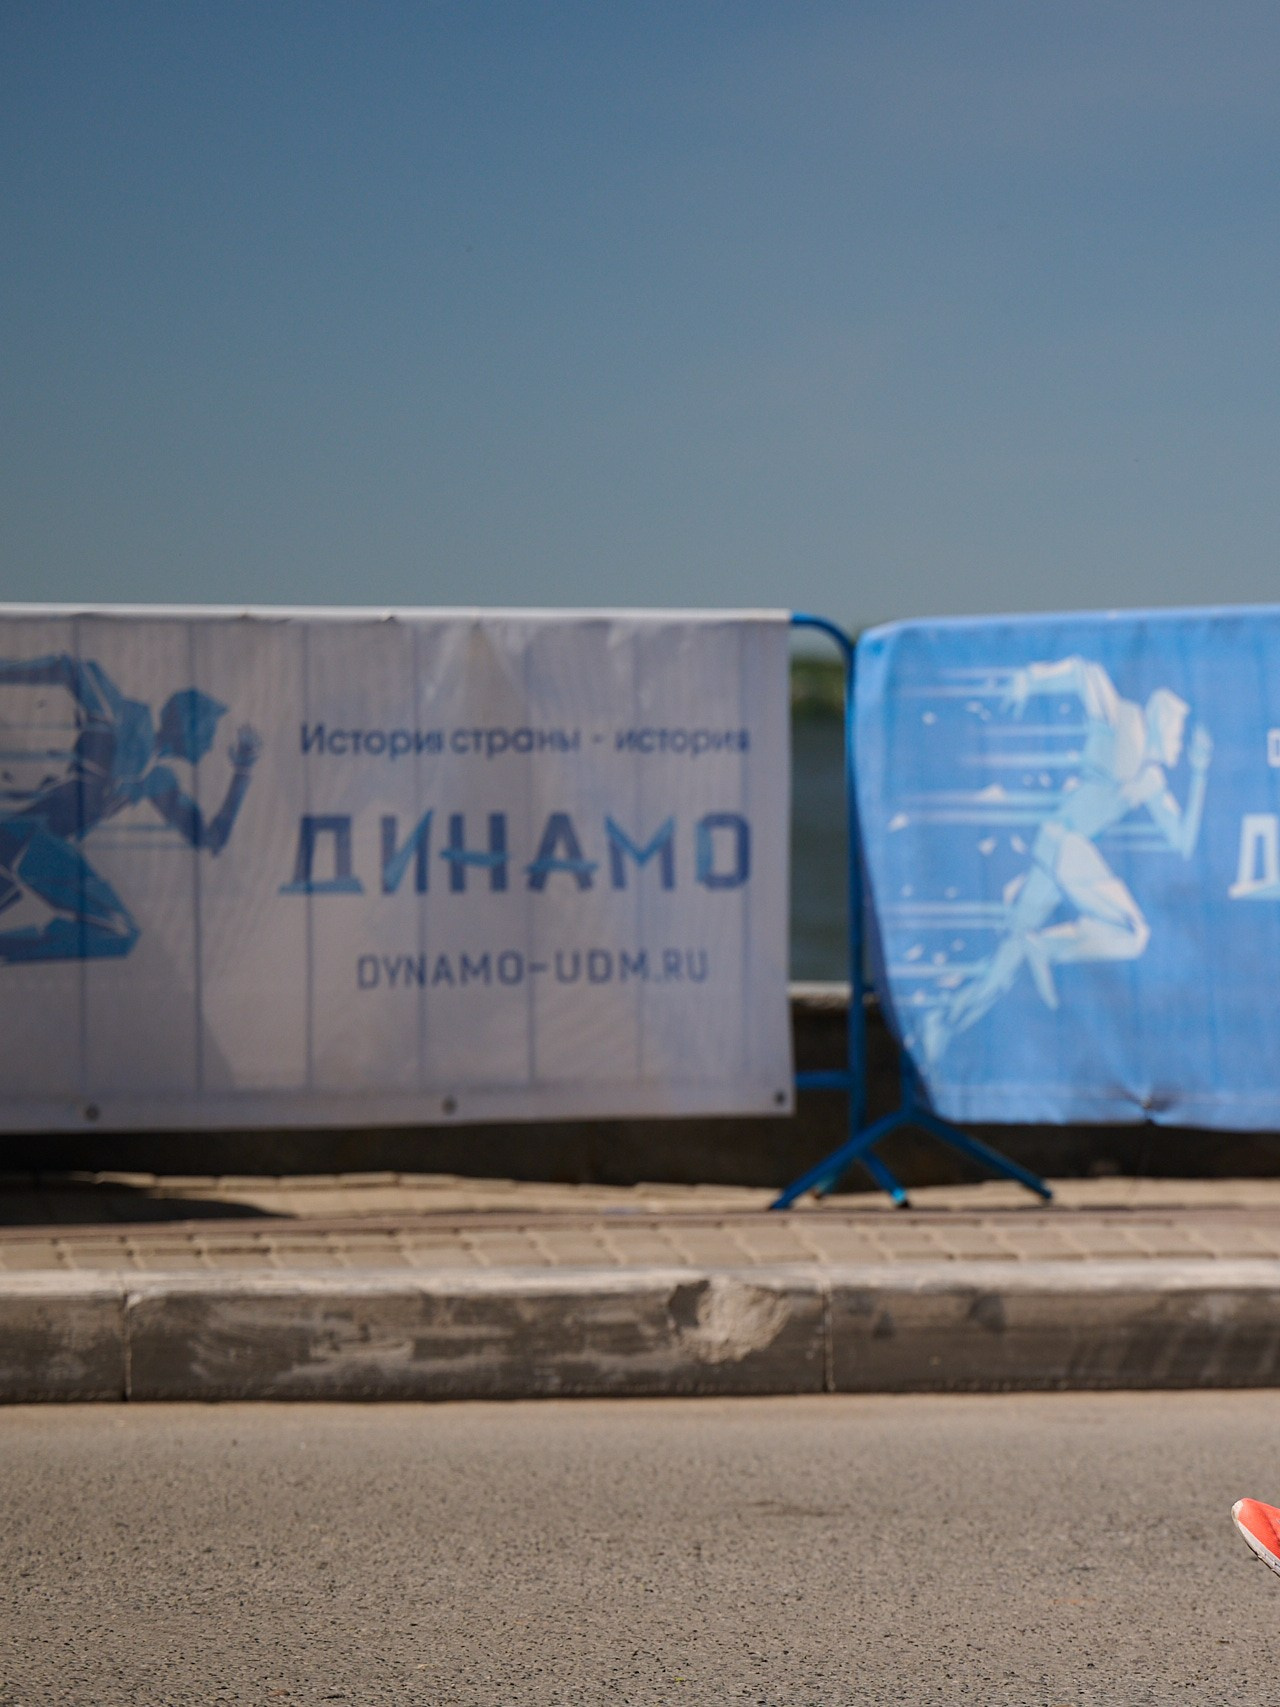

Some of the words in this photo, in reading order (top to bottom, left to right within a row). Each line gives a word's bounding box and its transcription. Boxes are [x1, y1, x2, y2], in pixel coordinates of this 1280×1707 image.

[303, 722, 443, 759] История
[452, 725, 580, 759] страны
[615, 723, 750, 759] история
[278, 809, 751, 895] ДИНАМО
[358, 948, 708, 989] DYNAMO-UDM.RU
